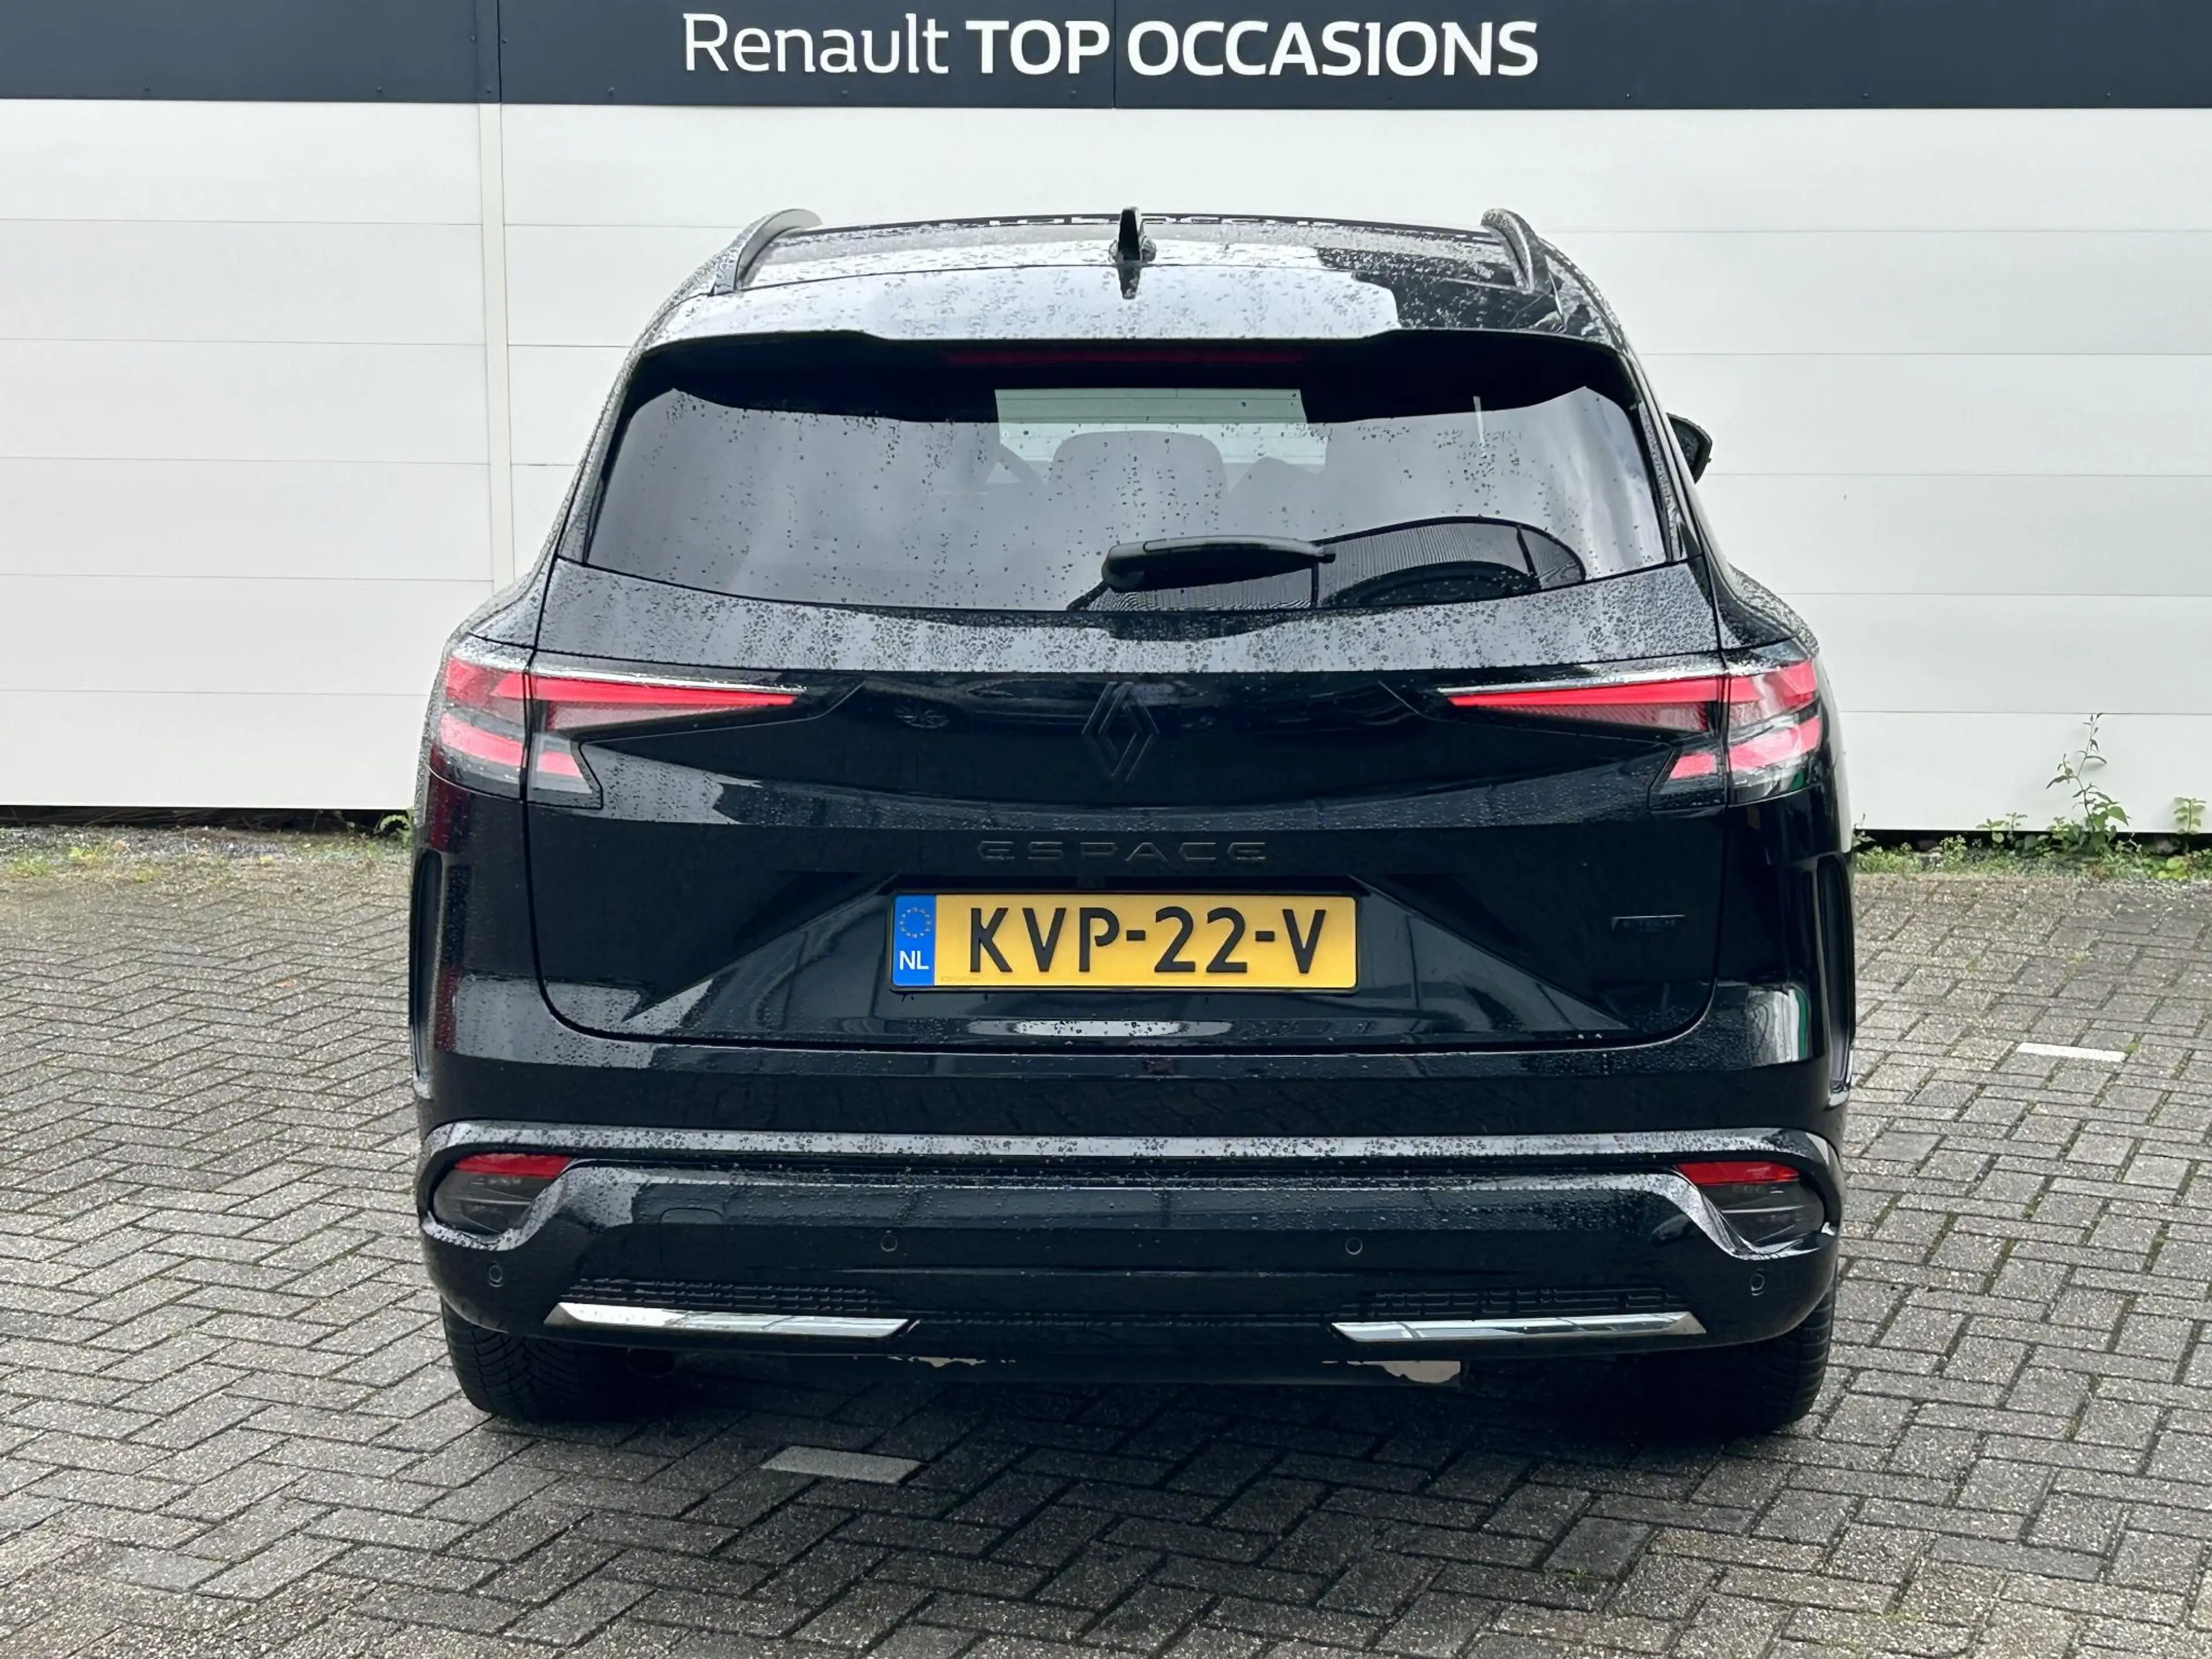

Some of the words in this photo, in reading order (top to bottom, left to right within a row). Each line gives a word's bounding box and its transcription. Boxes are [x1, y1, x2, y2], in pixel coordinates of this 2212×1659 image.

[683, 13, 949, 74] Renault
[965, 20, 1110, 75] TOP
[1127, 20, 1538, 77] OCCASIONS
[978, 840, 1267, 862] ESPACE
[899, 950, 930, 971] NL
[970, 907, 1327, 974] KVP-22-V
